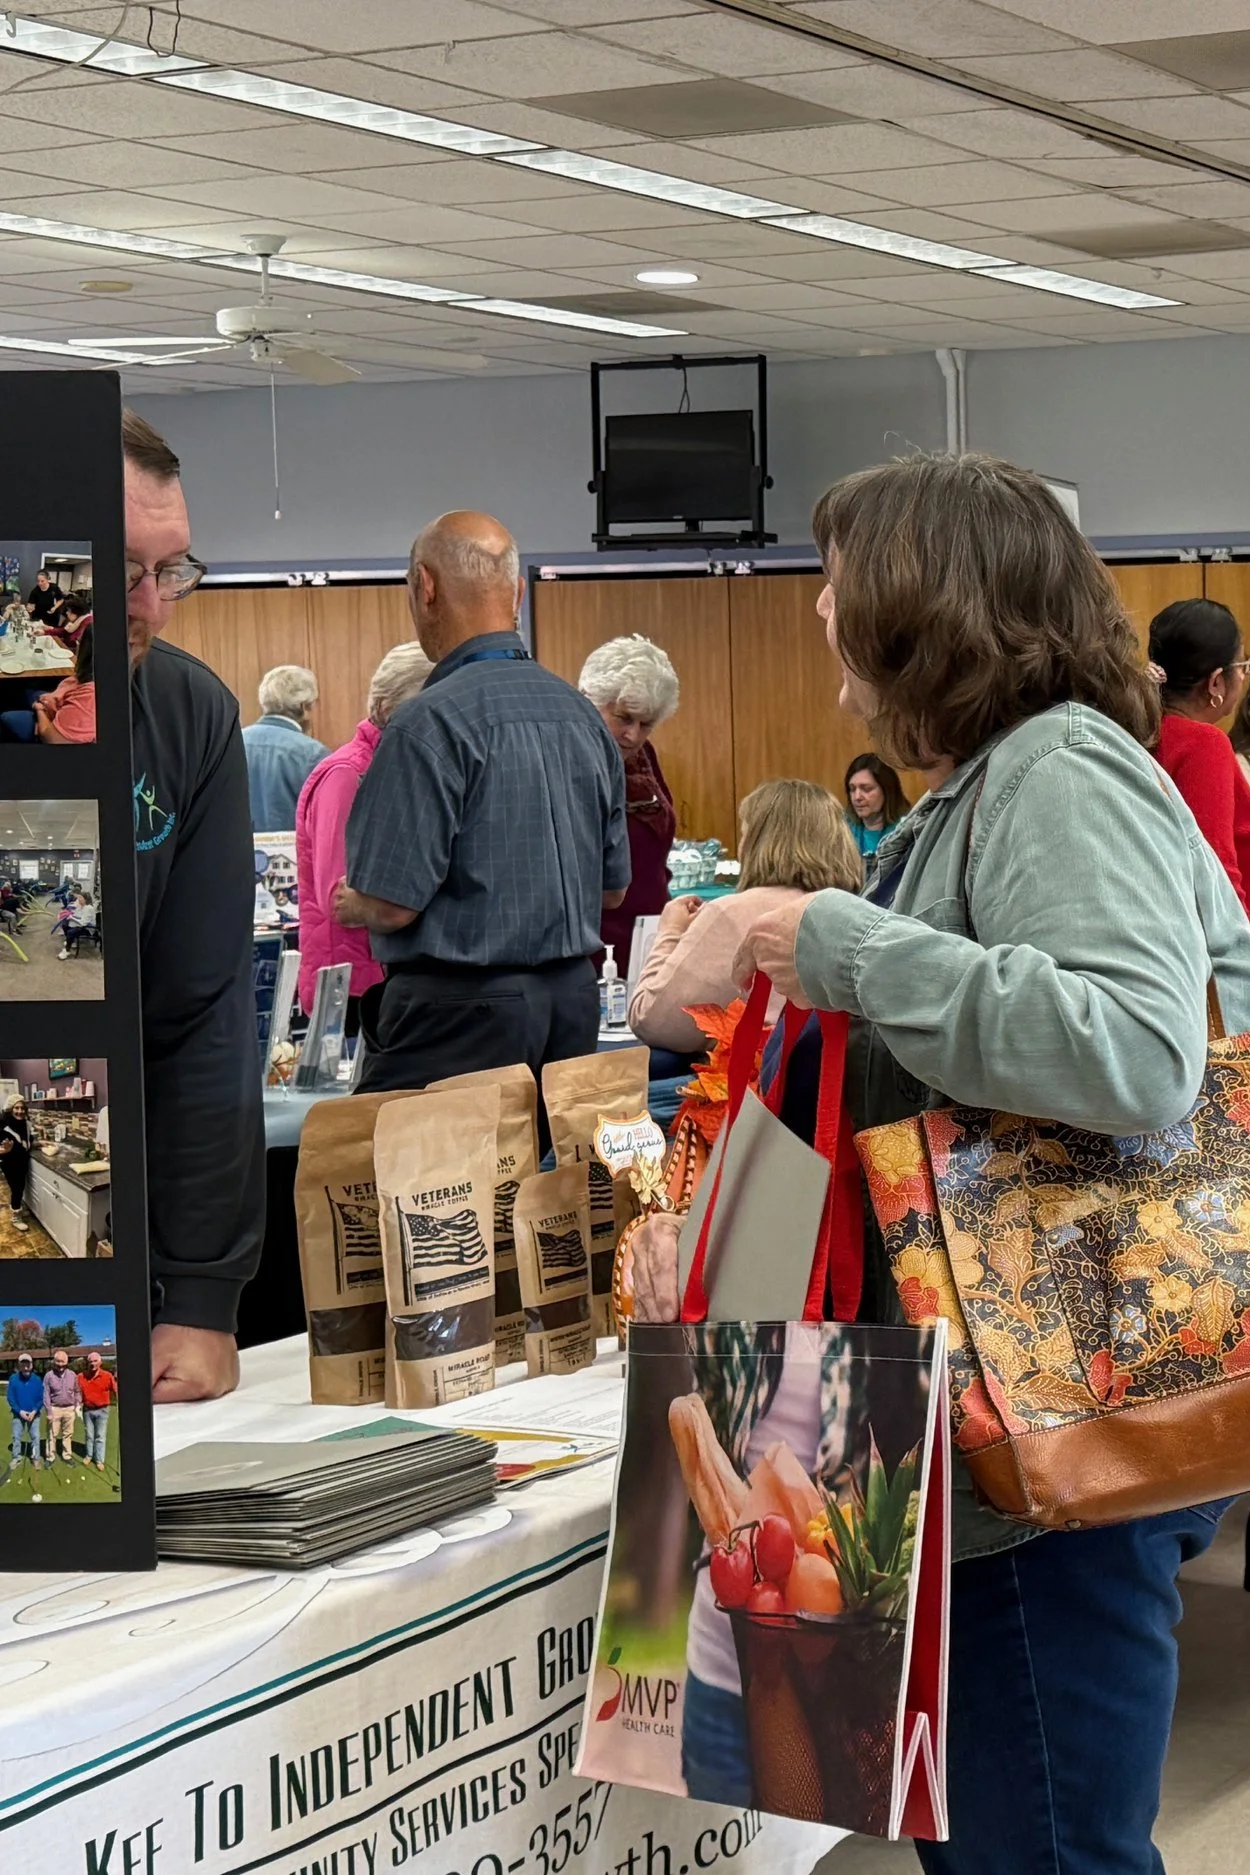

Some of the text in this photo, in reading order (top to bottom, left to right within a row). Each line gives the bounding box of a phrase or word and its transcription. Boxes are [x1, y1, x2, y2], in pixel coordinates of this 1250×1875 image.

[411, 1181, 473, 1206] VETERANS
[538, 1211, 578, 1228] VETERANS
[448, 1359, 475, 1372] MIRACLE
[538, 1612, 597, 1700] GRO
[622, 1673, 677, 1720] MVP
[622, 1719, 675, 1737] HEALTH CARE
[538, 1720, 582, 1789] SPE
[604, 1808, 763, 1875] th.com
